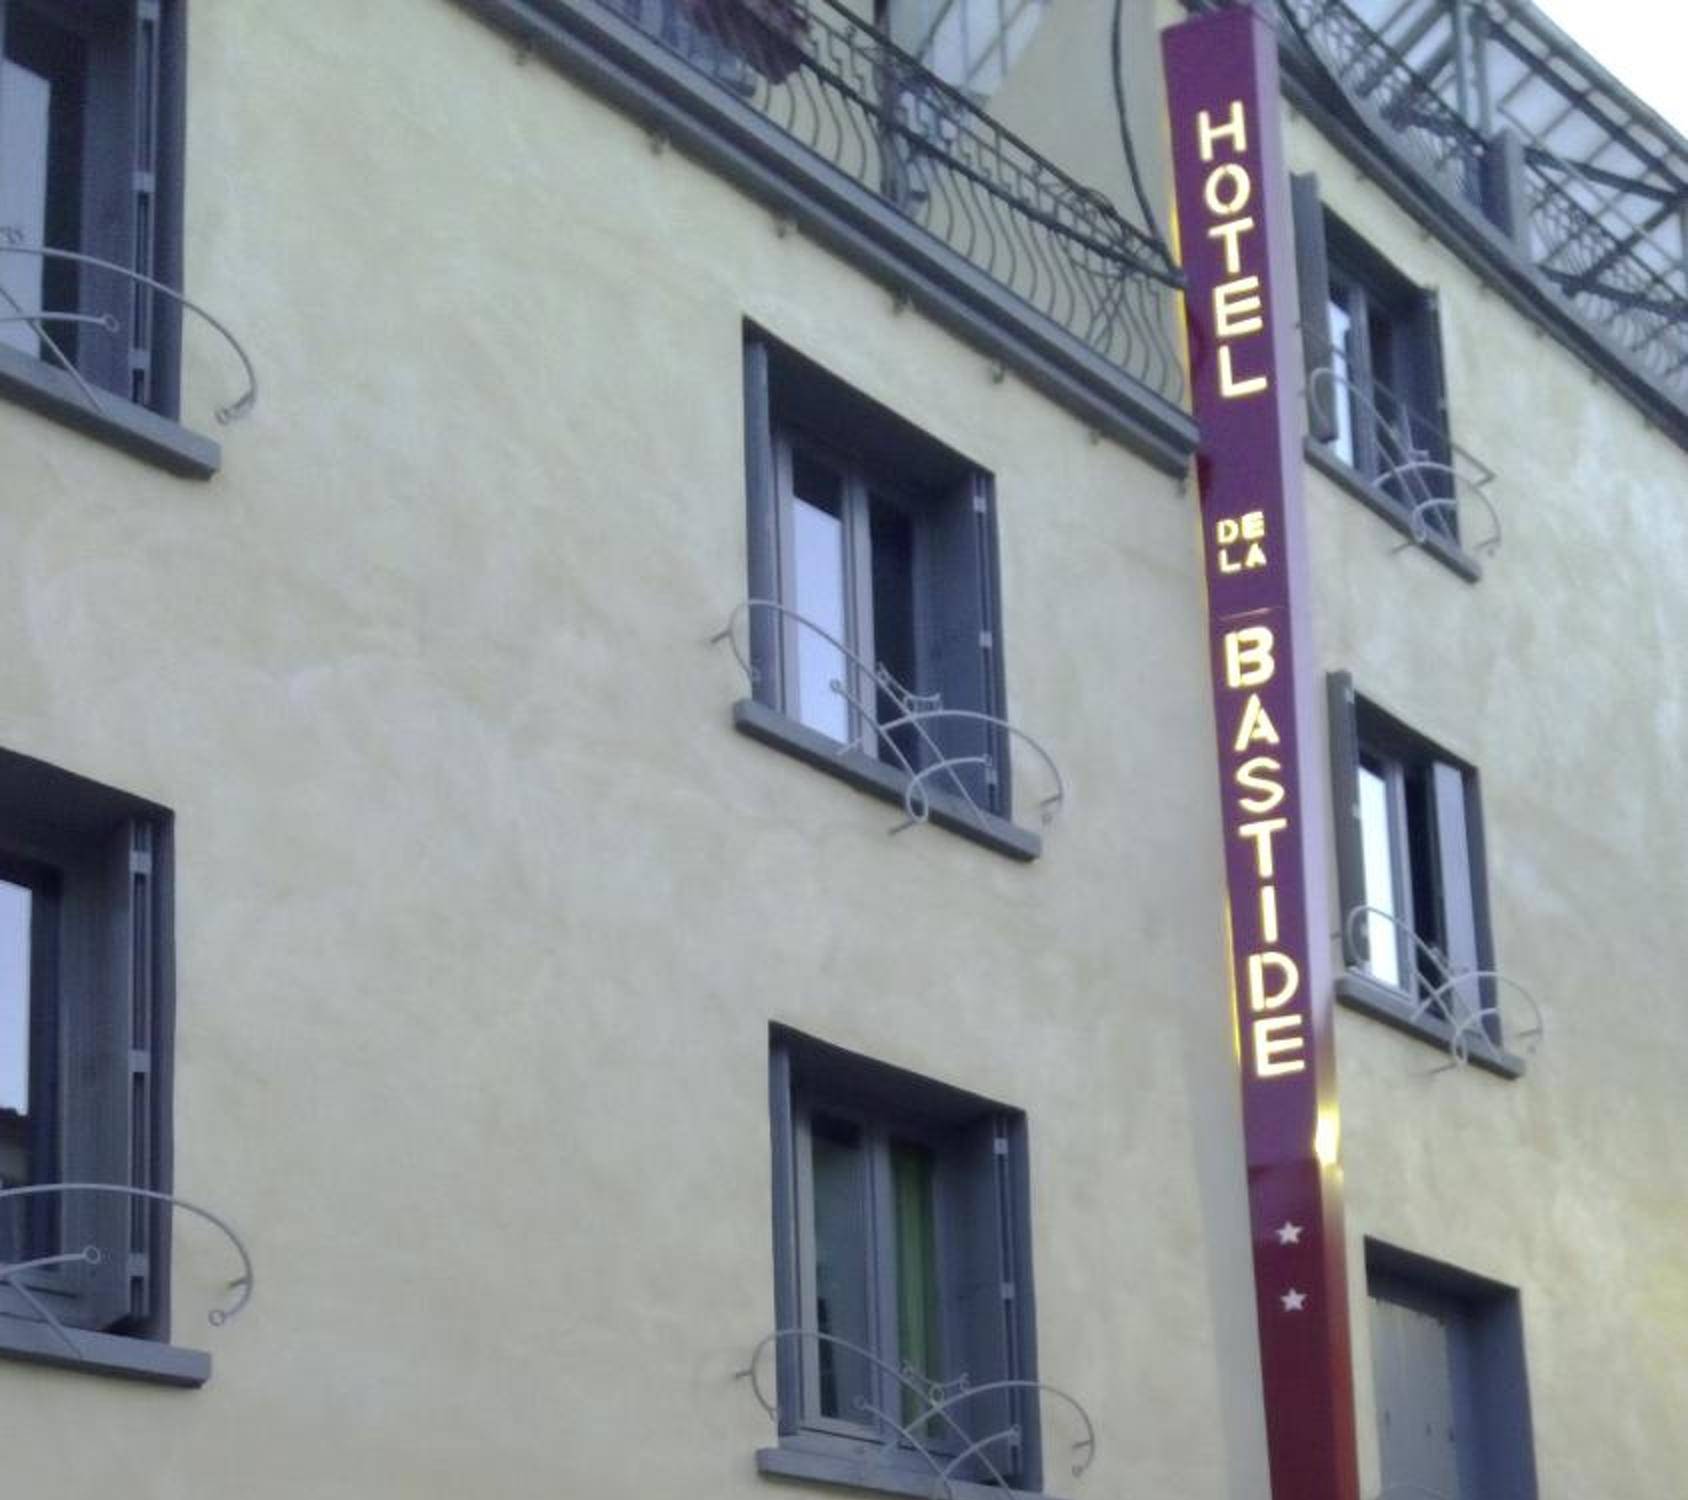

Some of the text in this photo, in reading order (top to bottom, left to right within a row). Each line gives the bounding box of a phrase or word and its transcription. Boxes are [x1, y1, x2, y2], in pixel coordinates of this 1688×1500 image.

[1197, 100, 1267, 399] HOTEL
[1216, 511, 1266, 546] DE
[1217, 545, 1267, 574] LA
[1223, 625, 1306, 1079] BASTIDE
